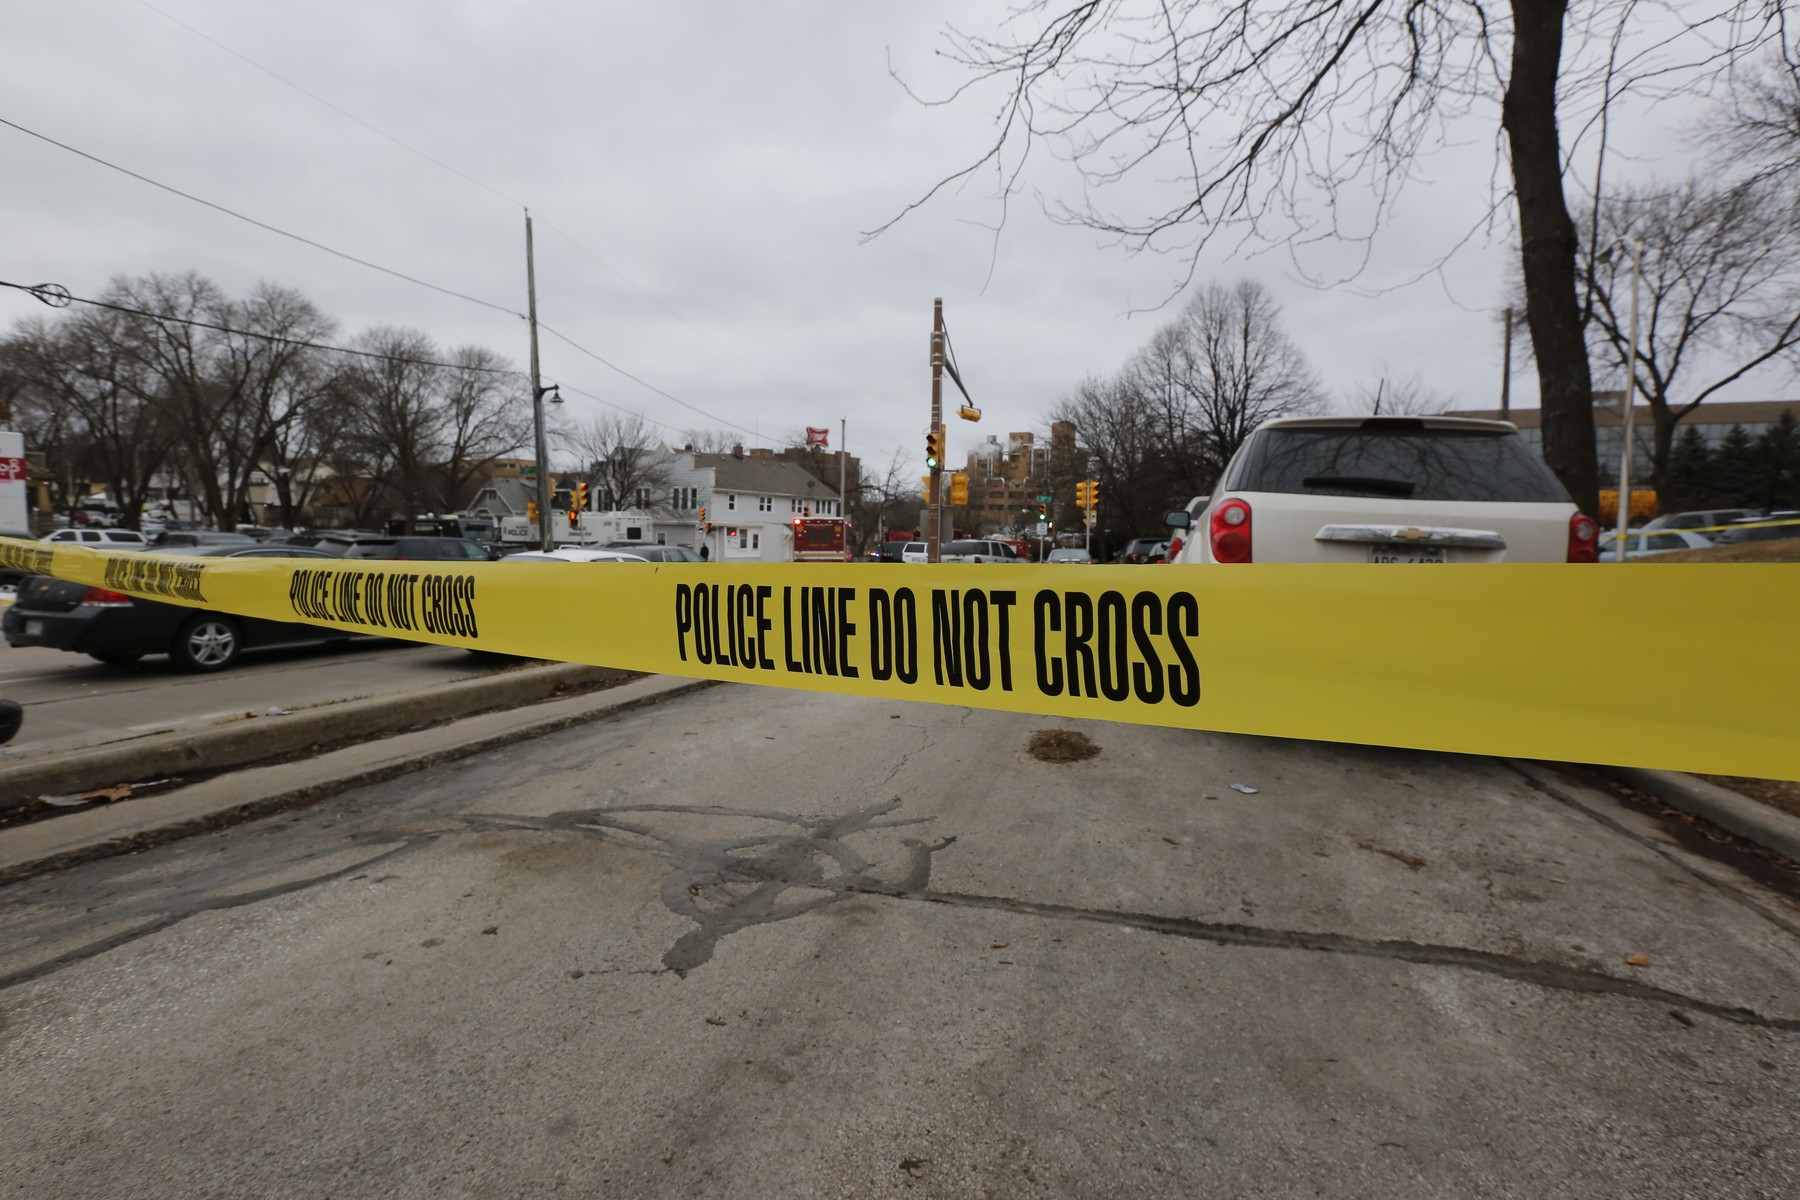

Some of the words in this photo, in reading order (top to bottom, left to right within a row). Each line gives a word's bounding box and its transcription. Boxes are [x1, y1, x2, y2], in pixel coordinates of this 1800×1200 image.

[289, 569, 336, 621] POLICE
[332, 571, 367, 625] LINE
[365, 572, 388, 628] DO
[387, 573, 420, 632] NOT
[421, 573, 479, 639] CROSS
[675, 582, 776, 671] POLICE
[783, 585, 860, 679] LINE
[868, 586, 919, 685] DO
[931, 587, 1017, 692] NOT
[1033, 588, 1201, 708] CROSS
